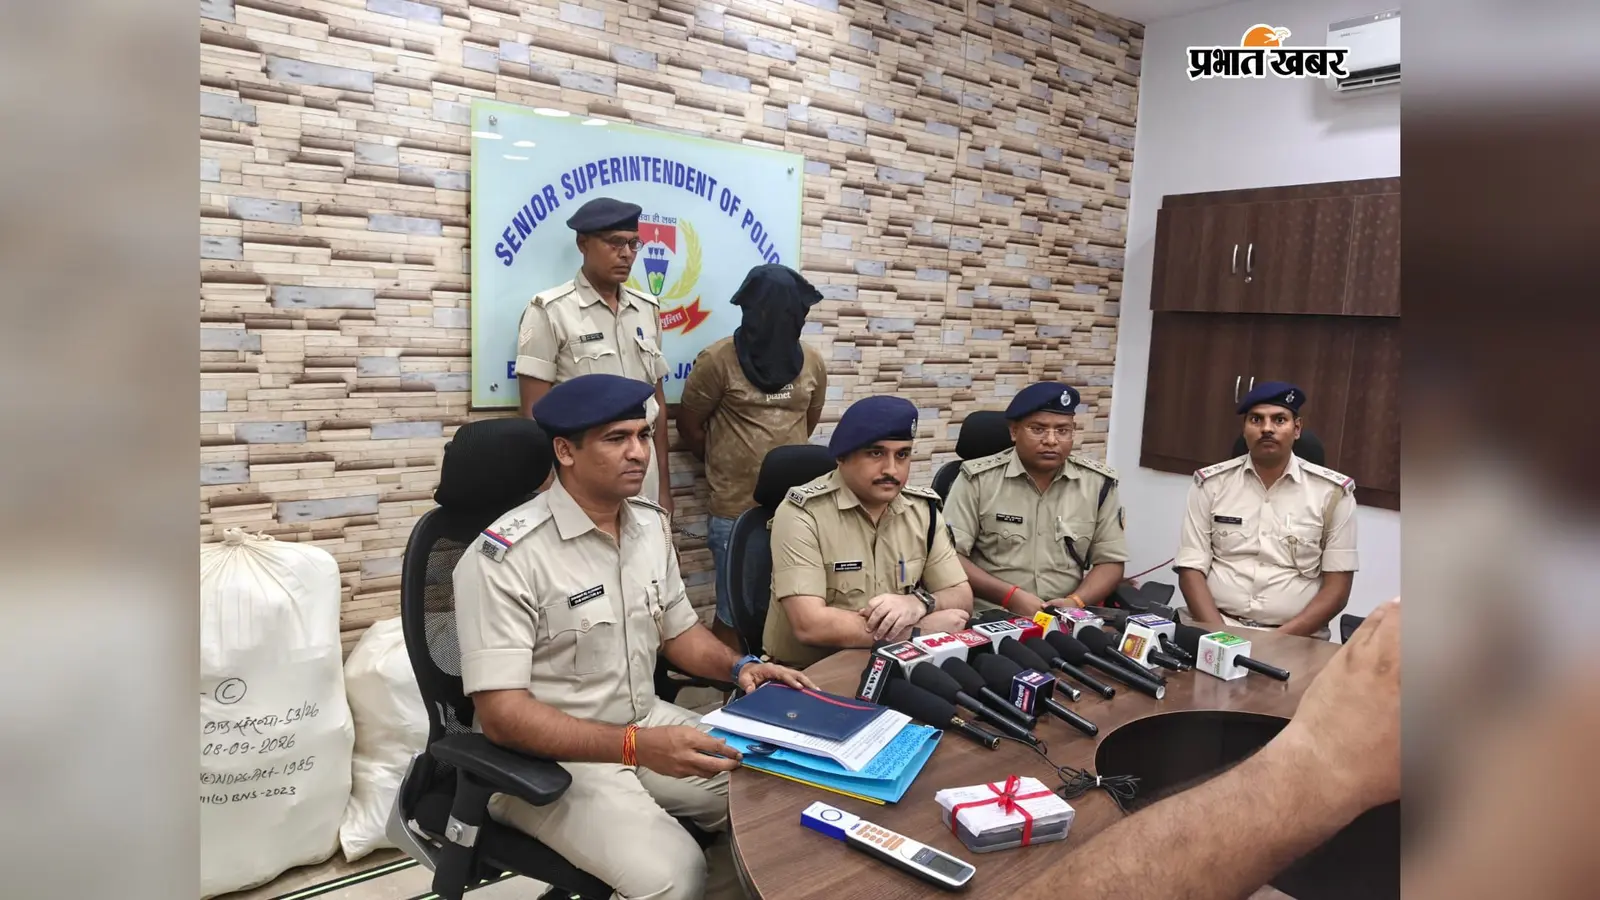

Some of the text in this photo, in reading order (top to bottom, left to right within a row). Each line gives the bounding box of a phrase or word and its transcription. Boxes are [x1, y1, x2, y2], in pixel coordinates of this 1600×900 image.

[495, 155, 781, 267] SENIOR SUPERINTENDENT OF POLIC
[765, 391, 792, 402] planet
[986, 620, 1016, 634] ANI
